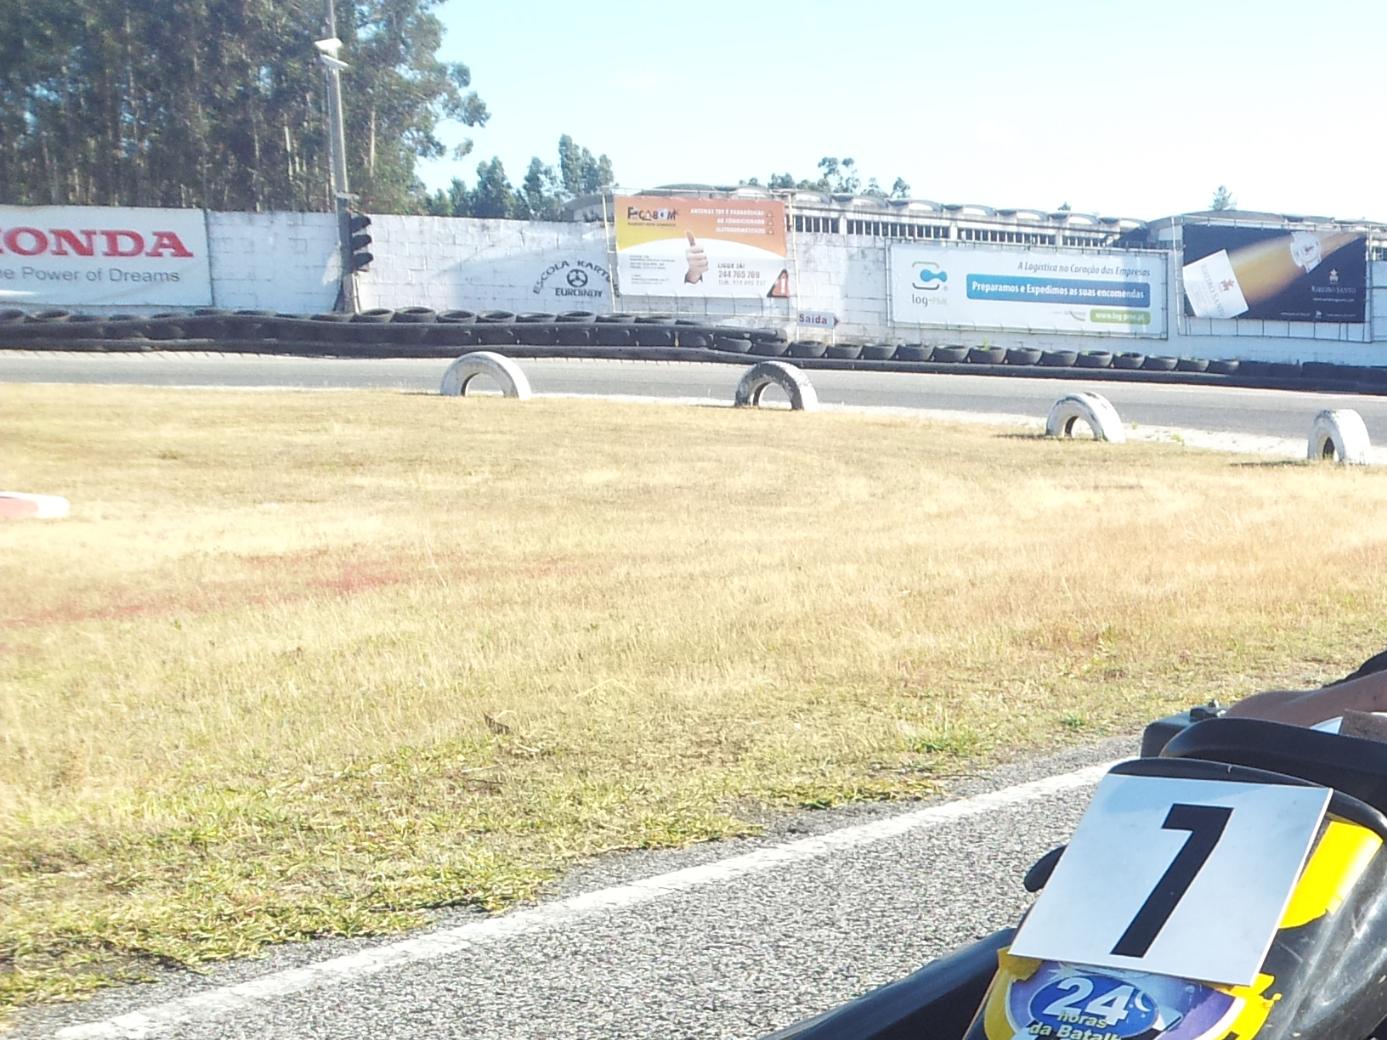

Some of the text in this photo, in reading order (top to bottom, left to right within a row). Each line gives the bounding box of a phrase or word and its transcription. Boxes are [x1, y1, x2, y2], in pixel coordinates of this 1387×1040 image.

[0, 227, 194, 258] ONDA
[22, 267, 79, 281] Power
[86, 267, 102, 282] of
[108, 267, 180, 282] Dreams
[972, 281, 1145, 299] Preparamos e Expedimos as suas encomendas
[1110, 803, 1235, 959] 7
[1042, 975, 1135, 1027] 24
[1029, 1021, 1052, 1037] da
